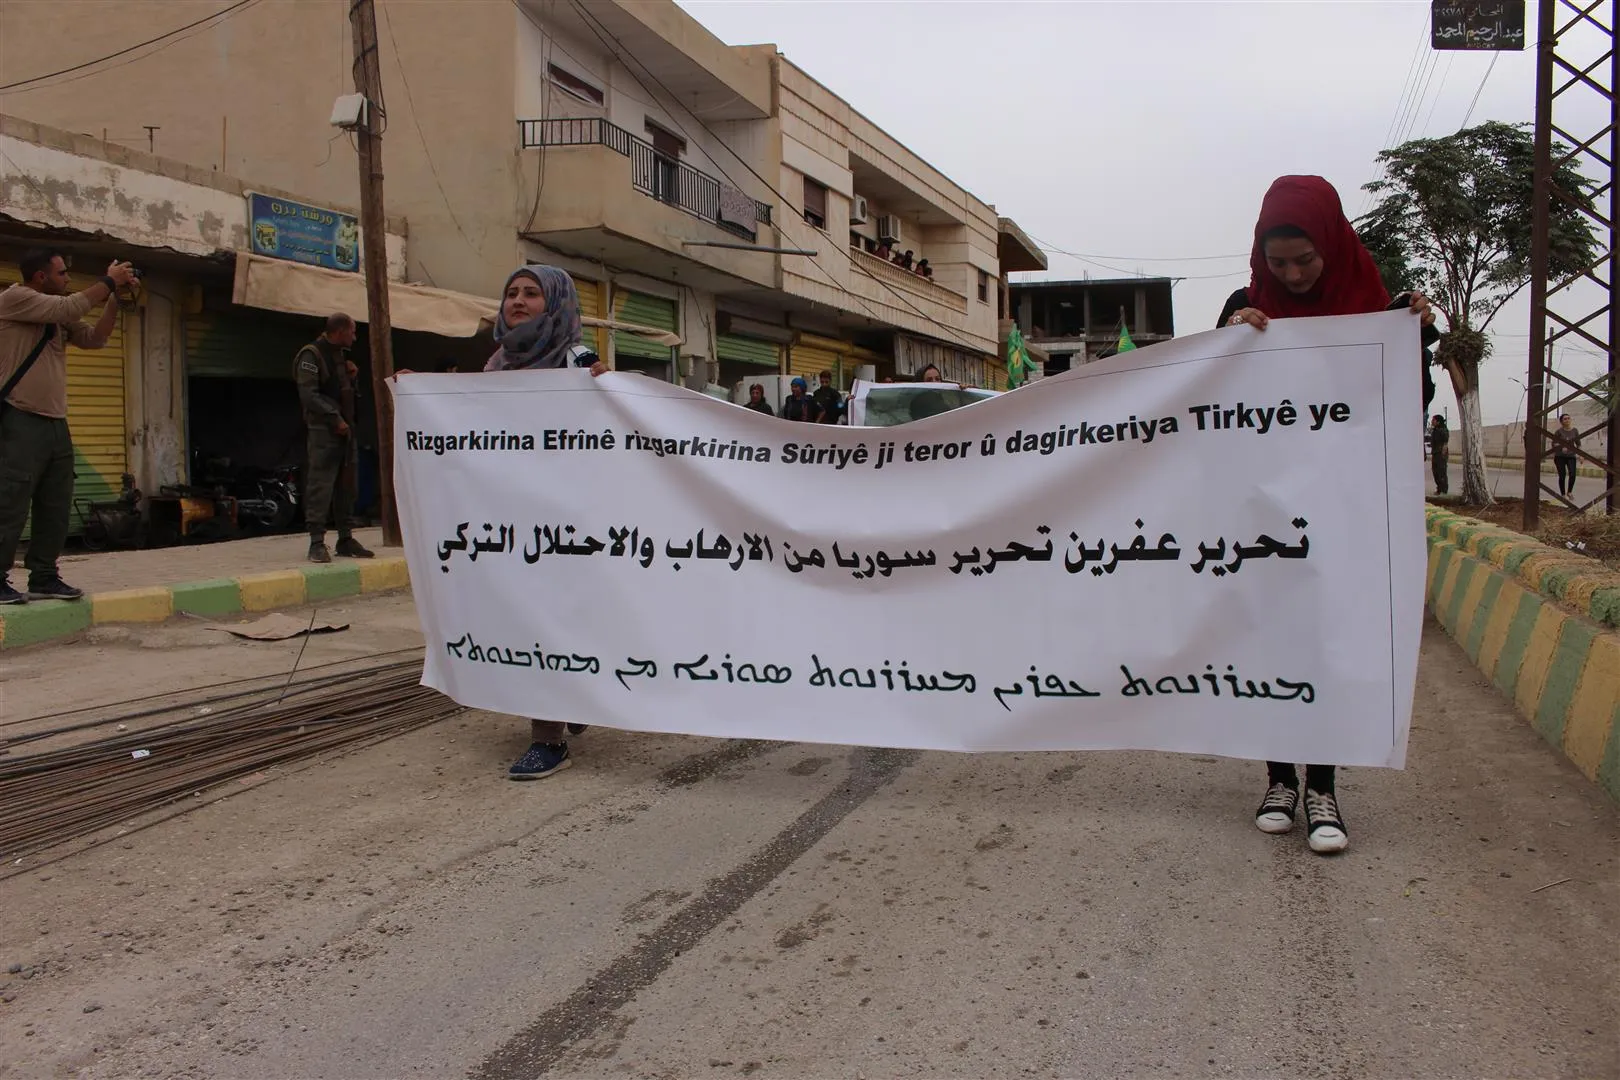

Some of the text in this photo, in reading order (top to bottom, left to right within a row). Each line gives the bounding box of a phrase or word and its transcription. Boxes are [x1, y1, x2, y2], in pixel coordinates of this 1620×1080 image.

[302, 207, 333, 226] ورشة
[405, 399, 1351, 470] Rizgarkirina Efrînê rizgarkirina Sûriyê ji teror û dagirkeriya Tirkyê ye
[436, 516, 1310, 579] تحرير عفرين تحرير سوريا من الارهاب والاحتلال التركي
